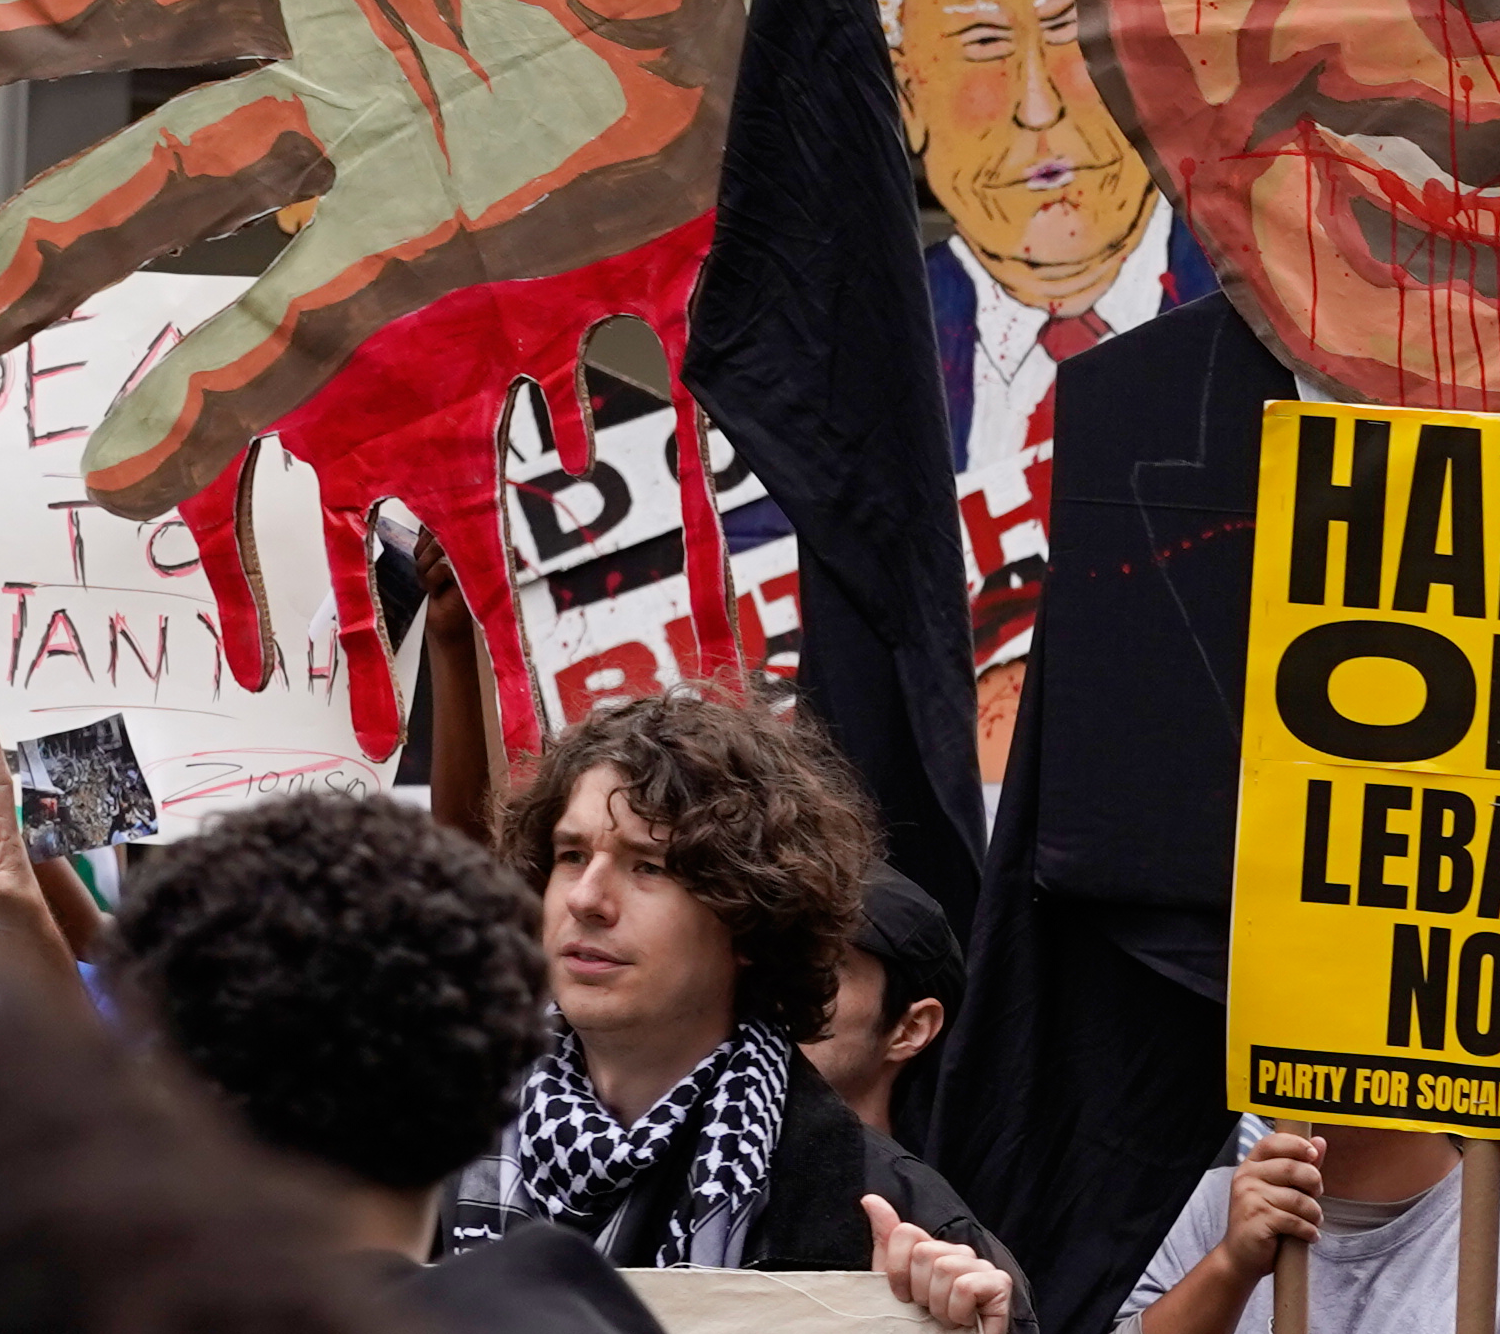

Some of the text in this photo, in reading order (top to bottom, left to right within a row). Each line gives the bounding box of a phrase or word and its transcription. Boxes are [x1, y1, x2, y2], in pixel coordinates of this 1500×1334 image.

[48, 500, 200, 592] TO
[1258, 1059, 1347, 1103] PARTY
[1355, 1068, 1409, 1108] FOR
